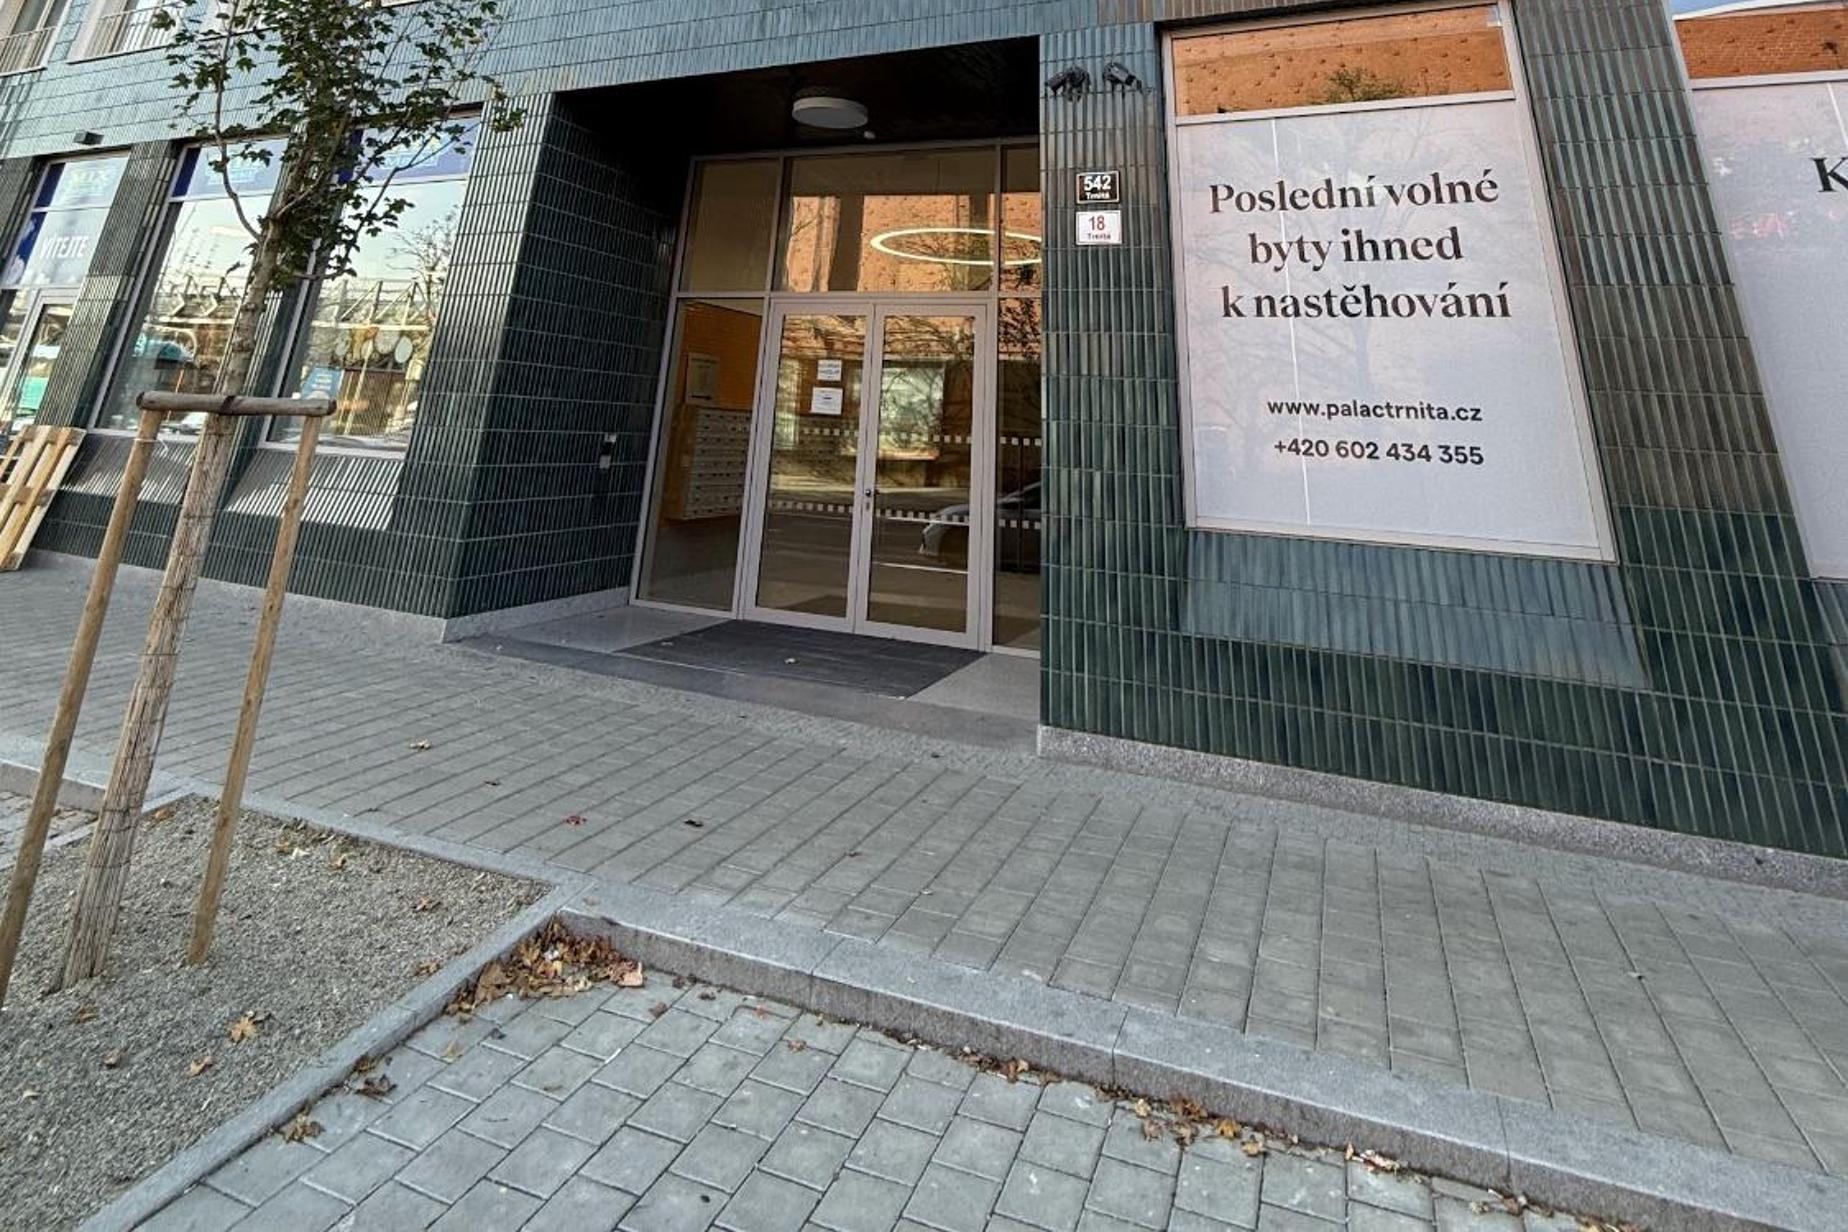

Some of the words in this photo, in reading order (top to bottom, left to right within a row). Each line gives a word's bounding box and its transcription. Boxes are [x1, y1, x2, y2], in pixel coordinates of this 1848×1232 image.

[1083, 174, 1112, 192] 542
[1208, 175, 1377, 214] Poslední
[1383, 168, 1499, 207] volné
[1088, 214, 1106, 231] 18
[1248, 232, 1333, 272] byty
[1341, 226, 1465, 263] ihned
[1221, 284, 1248, 319] k
[1253, 281, 1513, 319] nastěhování
[1267, 399, 1484, 422] www.palactrnita.cz
[1274, 437, 1330, 458] +420
[1335, 440, 1381, 461] 602
[1386, 442, 1432, 463] 434
[1437, 444, 1485, 466] 355
